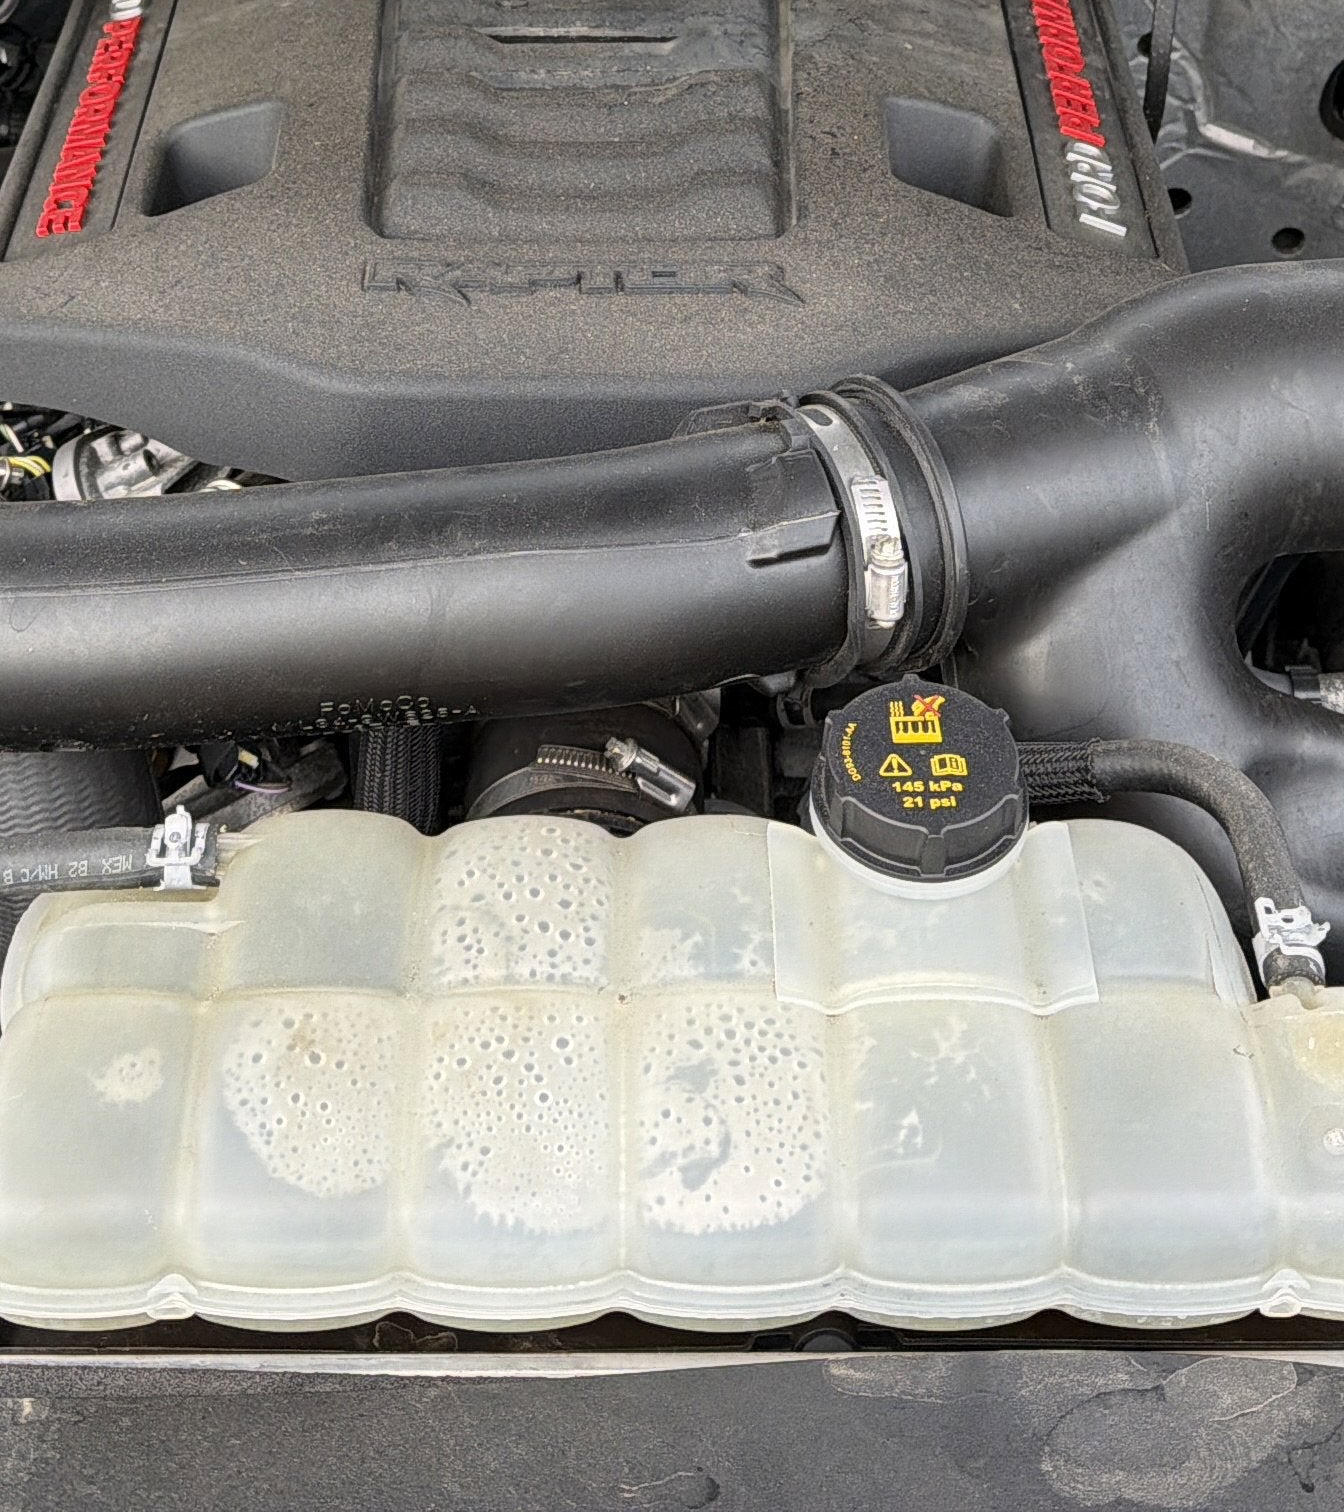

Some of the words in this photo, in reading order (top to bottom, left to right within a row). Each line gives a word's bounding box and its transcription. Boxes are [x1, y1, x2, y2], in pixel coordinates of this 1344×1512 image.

[36, 17, 143, 238] PERFORMANCE
[1064, 141, 1128, 237] FORD
[320, 695, 430, 715] FoMoCo
[892, 781, 925, 792] 145
[929, 780, 963, 792] kPa
[902, 796, 923, 808] 21
[929, 795, 957, 809] psi
[19, 862, 58, 883] HM/C
[68, 860, 88, 877] B2
[101, 854, 132, 874] MEX
[3, 869, 13, 885] B
